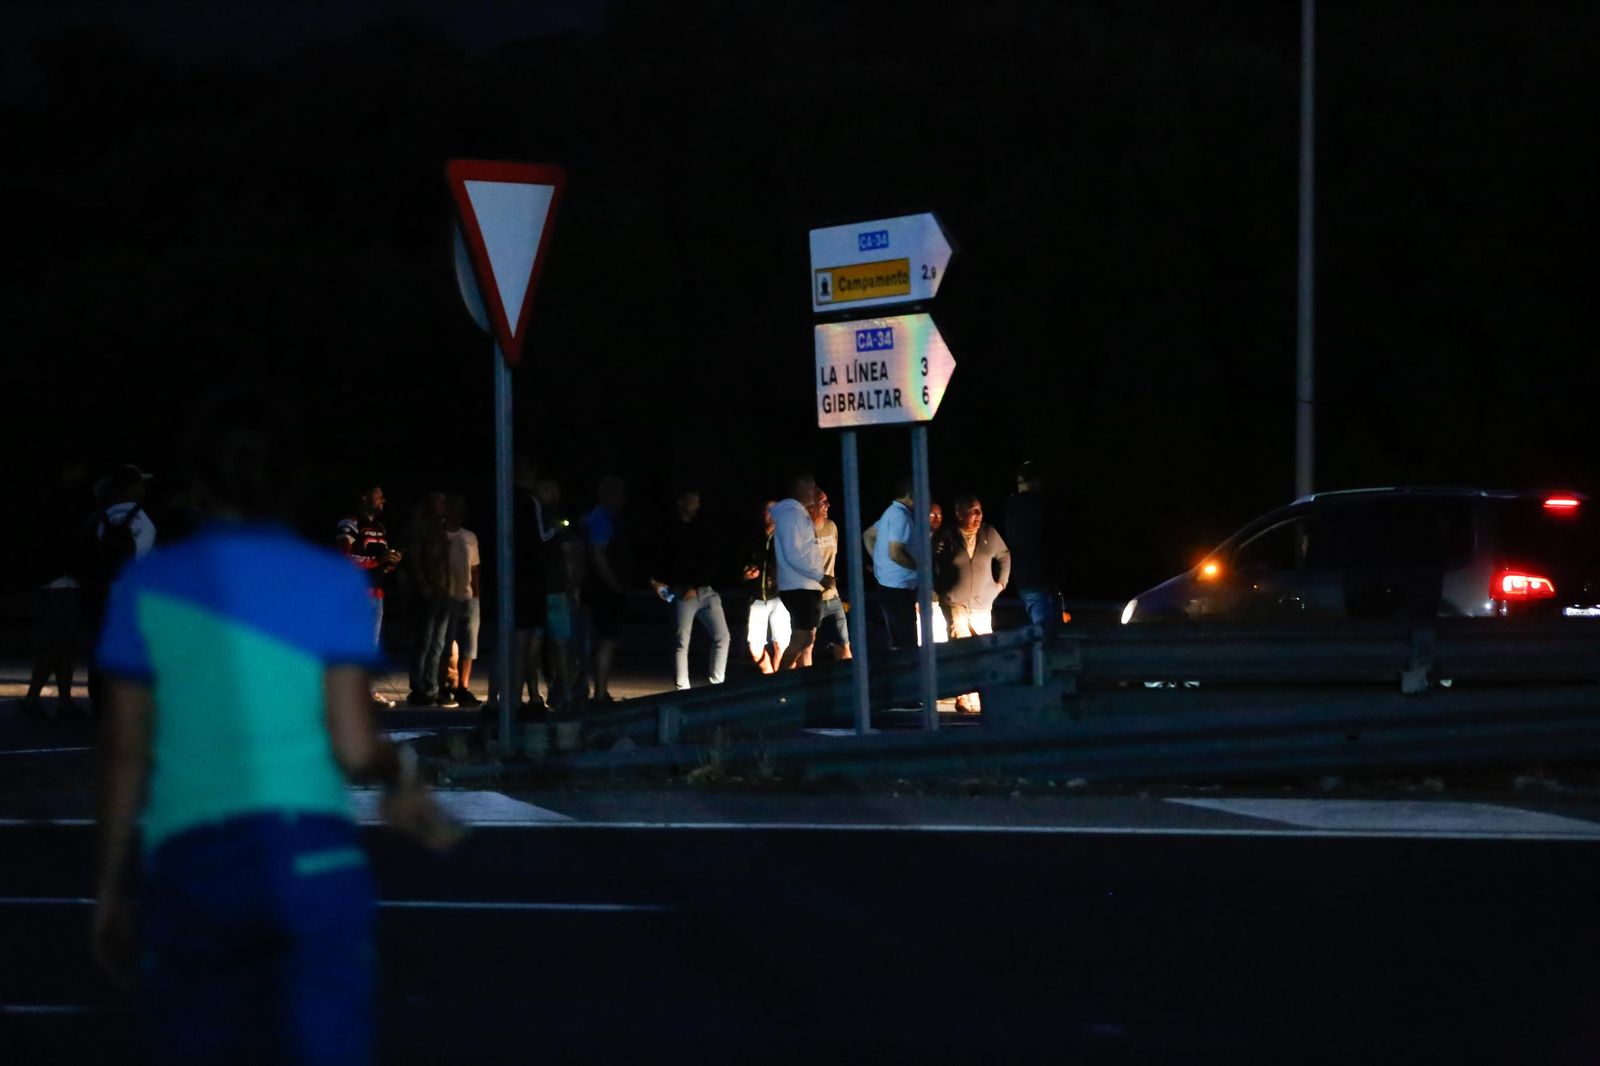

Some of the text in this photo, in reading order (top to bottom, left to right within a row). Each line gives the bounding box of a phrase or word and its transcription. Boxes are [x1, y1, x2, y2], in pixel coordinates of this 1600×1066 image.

[859, 232, 888, 249] CA-34
[838, 269, 908, 292] Campamento
[856, 329, 892, 349] CA-34
[820, 359, 889, 386] LA LÍNEA
[920, 357, 929, 377] 3
[822, 388, 902, 414] GIBRALTAR
[922, 386, 930, 406] 6
